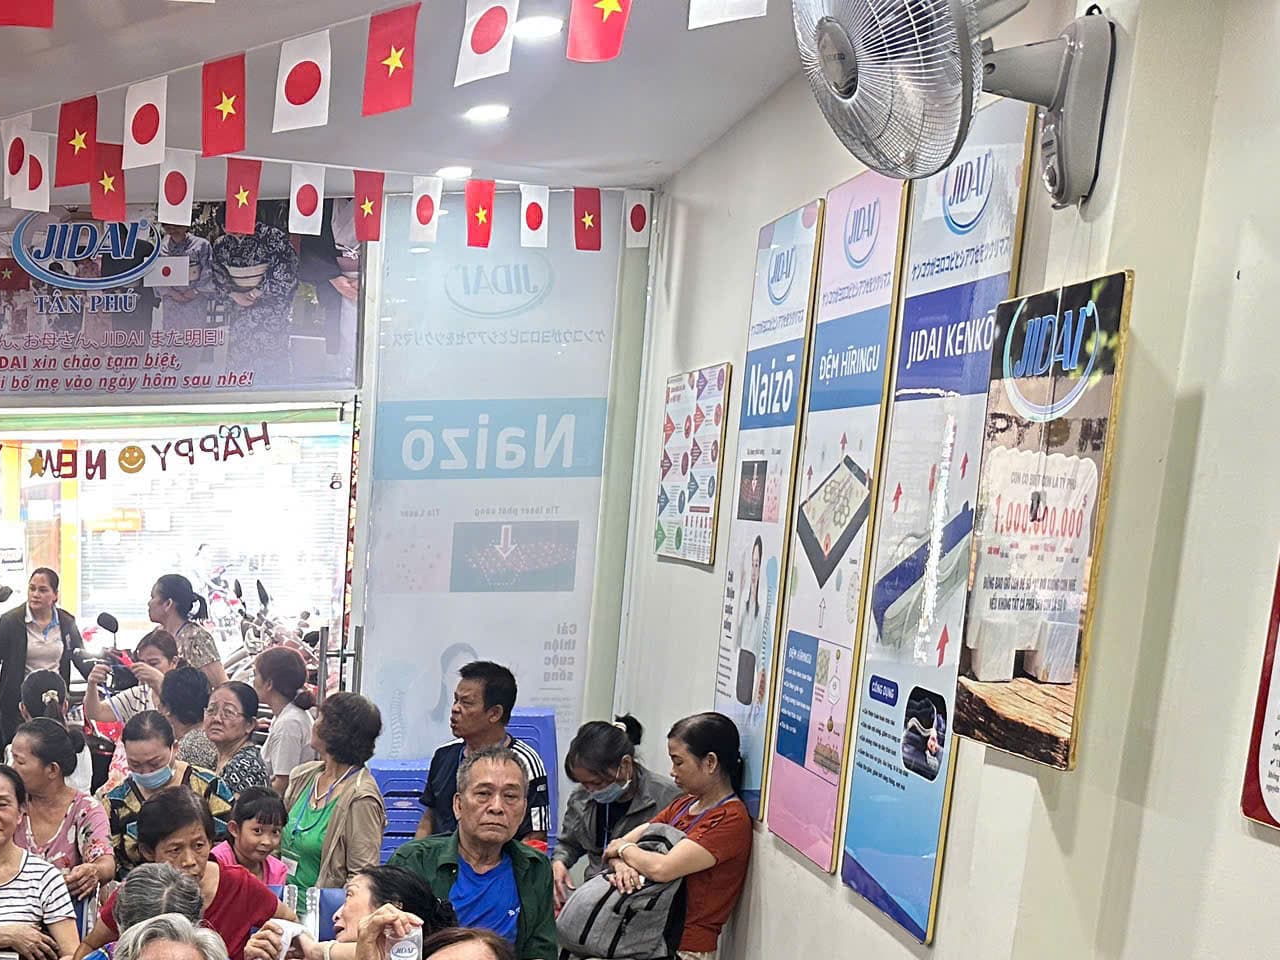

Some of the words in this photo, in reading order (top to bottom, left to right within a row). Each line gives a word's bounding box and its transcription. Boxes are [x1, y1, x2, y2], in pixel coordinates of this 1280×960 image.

[948, 153, 990, 207] JIDAI
[33, 222, 140, 261] JIDAI
[848, 201, 877, 245] JIDAI
[771, 246, 795, 285] JIDAI
[34, 288, 82, 314] TÂN
[89, 287, 138, 314] PHÚ
[905, 327, 943, 370] JIDAI
[944, 308, 996, 357] KENKŌ
[1014, 307, 1088, 378] JIDAI
[11, 374, 33, 390] bố
[36, 377, 60, 393] mẹ
[65, 375, 93, 389] vào
[98, 375, 138, 392] ngày
[142, 373, 178, 388] hôm
[182, 375, 212, 388] sau
[217, 371, 255, 387] nhé!
[32, 354, 58, 370] xin
[63, 354, 102, 370] chào
[107, 355, 139, 373] tạm
[144, 352, 182, 372] biệt,
[819, 345, 839, 386] ĐỆM
[840, 344, 881, 377] HĪRINGU
[747, 353, 796, 417] Naizō
